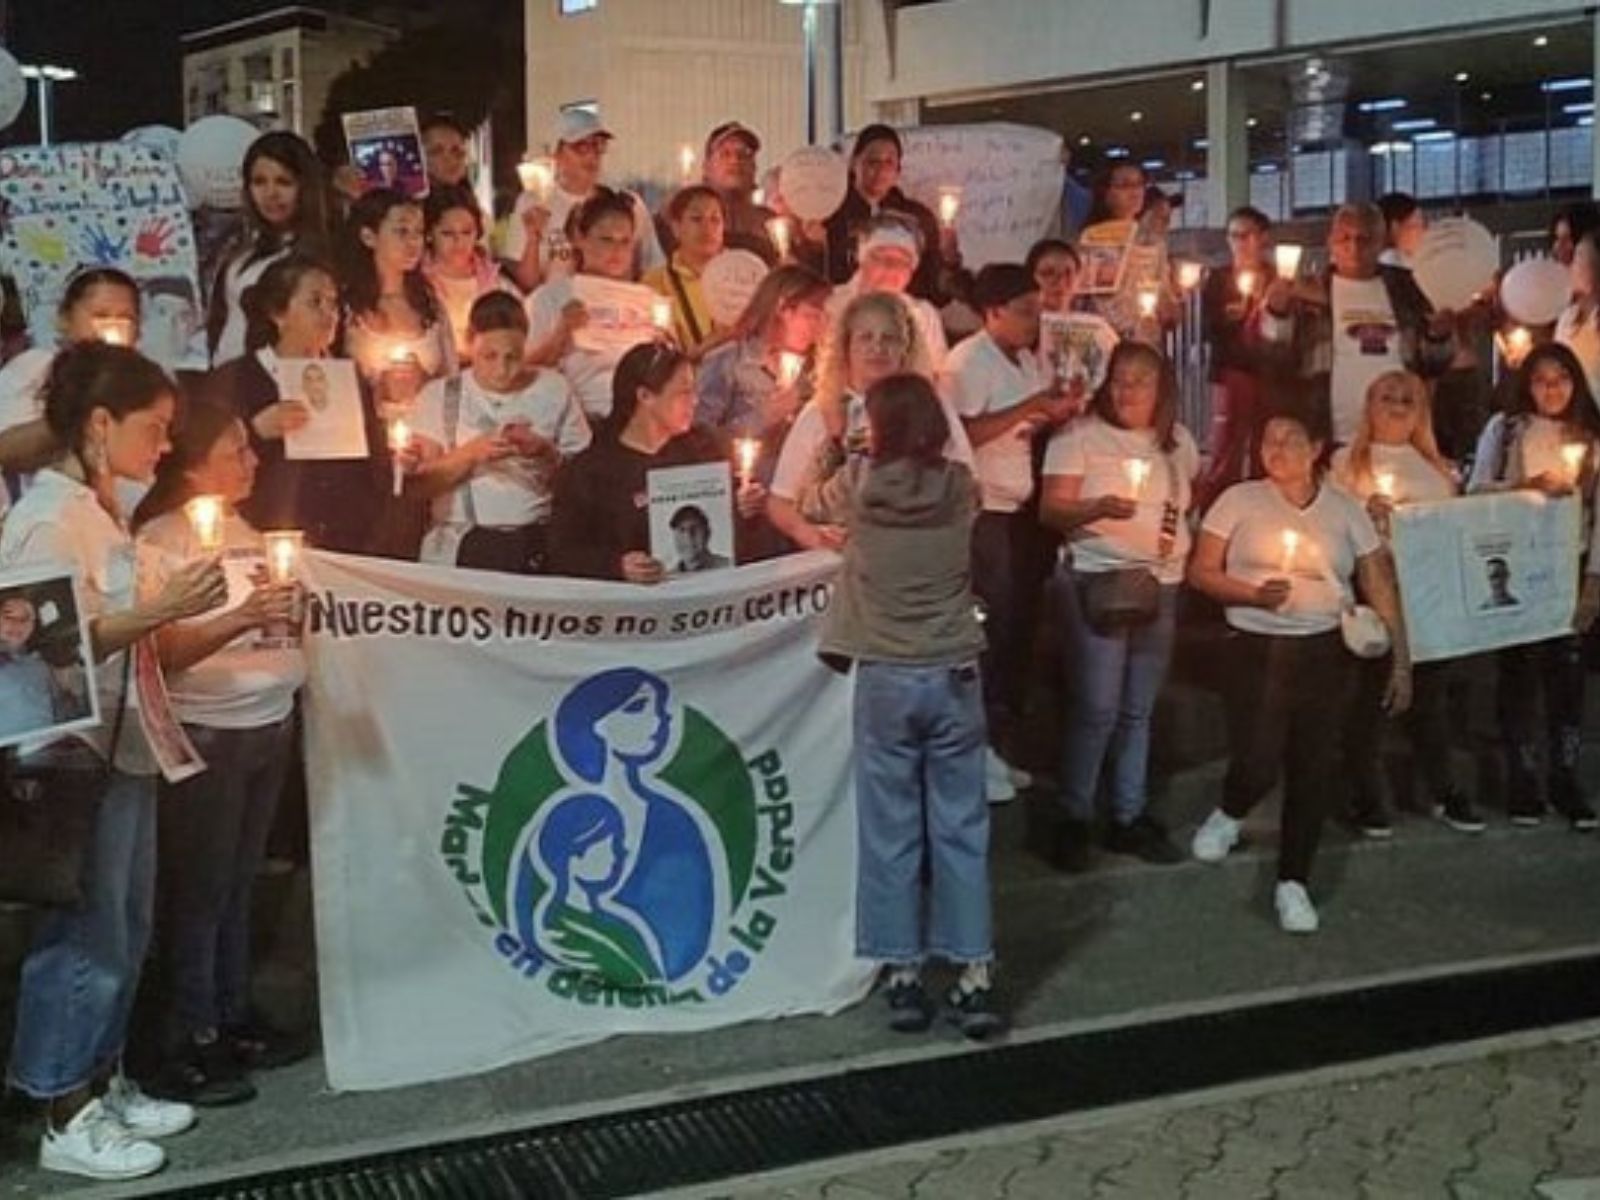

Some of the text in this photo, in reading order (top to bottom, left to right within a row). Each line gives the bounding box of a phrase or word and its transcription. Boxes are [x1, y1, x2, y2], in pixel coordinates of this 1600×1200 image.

[309, 590, 493, 640] Nuestros
[505, 606, 604, 641] hijos
[615, 615, 658, 635] no
[670, 604, 733, 633] son
[748, 748, 796, 901] Verdad
[495, 931, 544, 979] en
[729, 909, 778, 953] la
[707, 950, 751, 995] de
